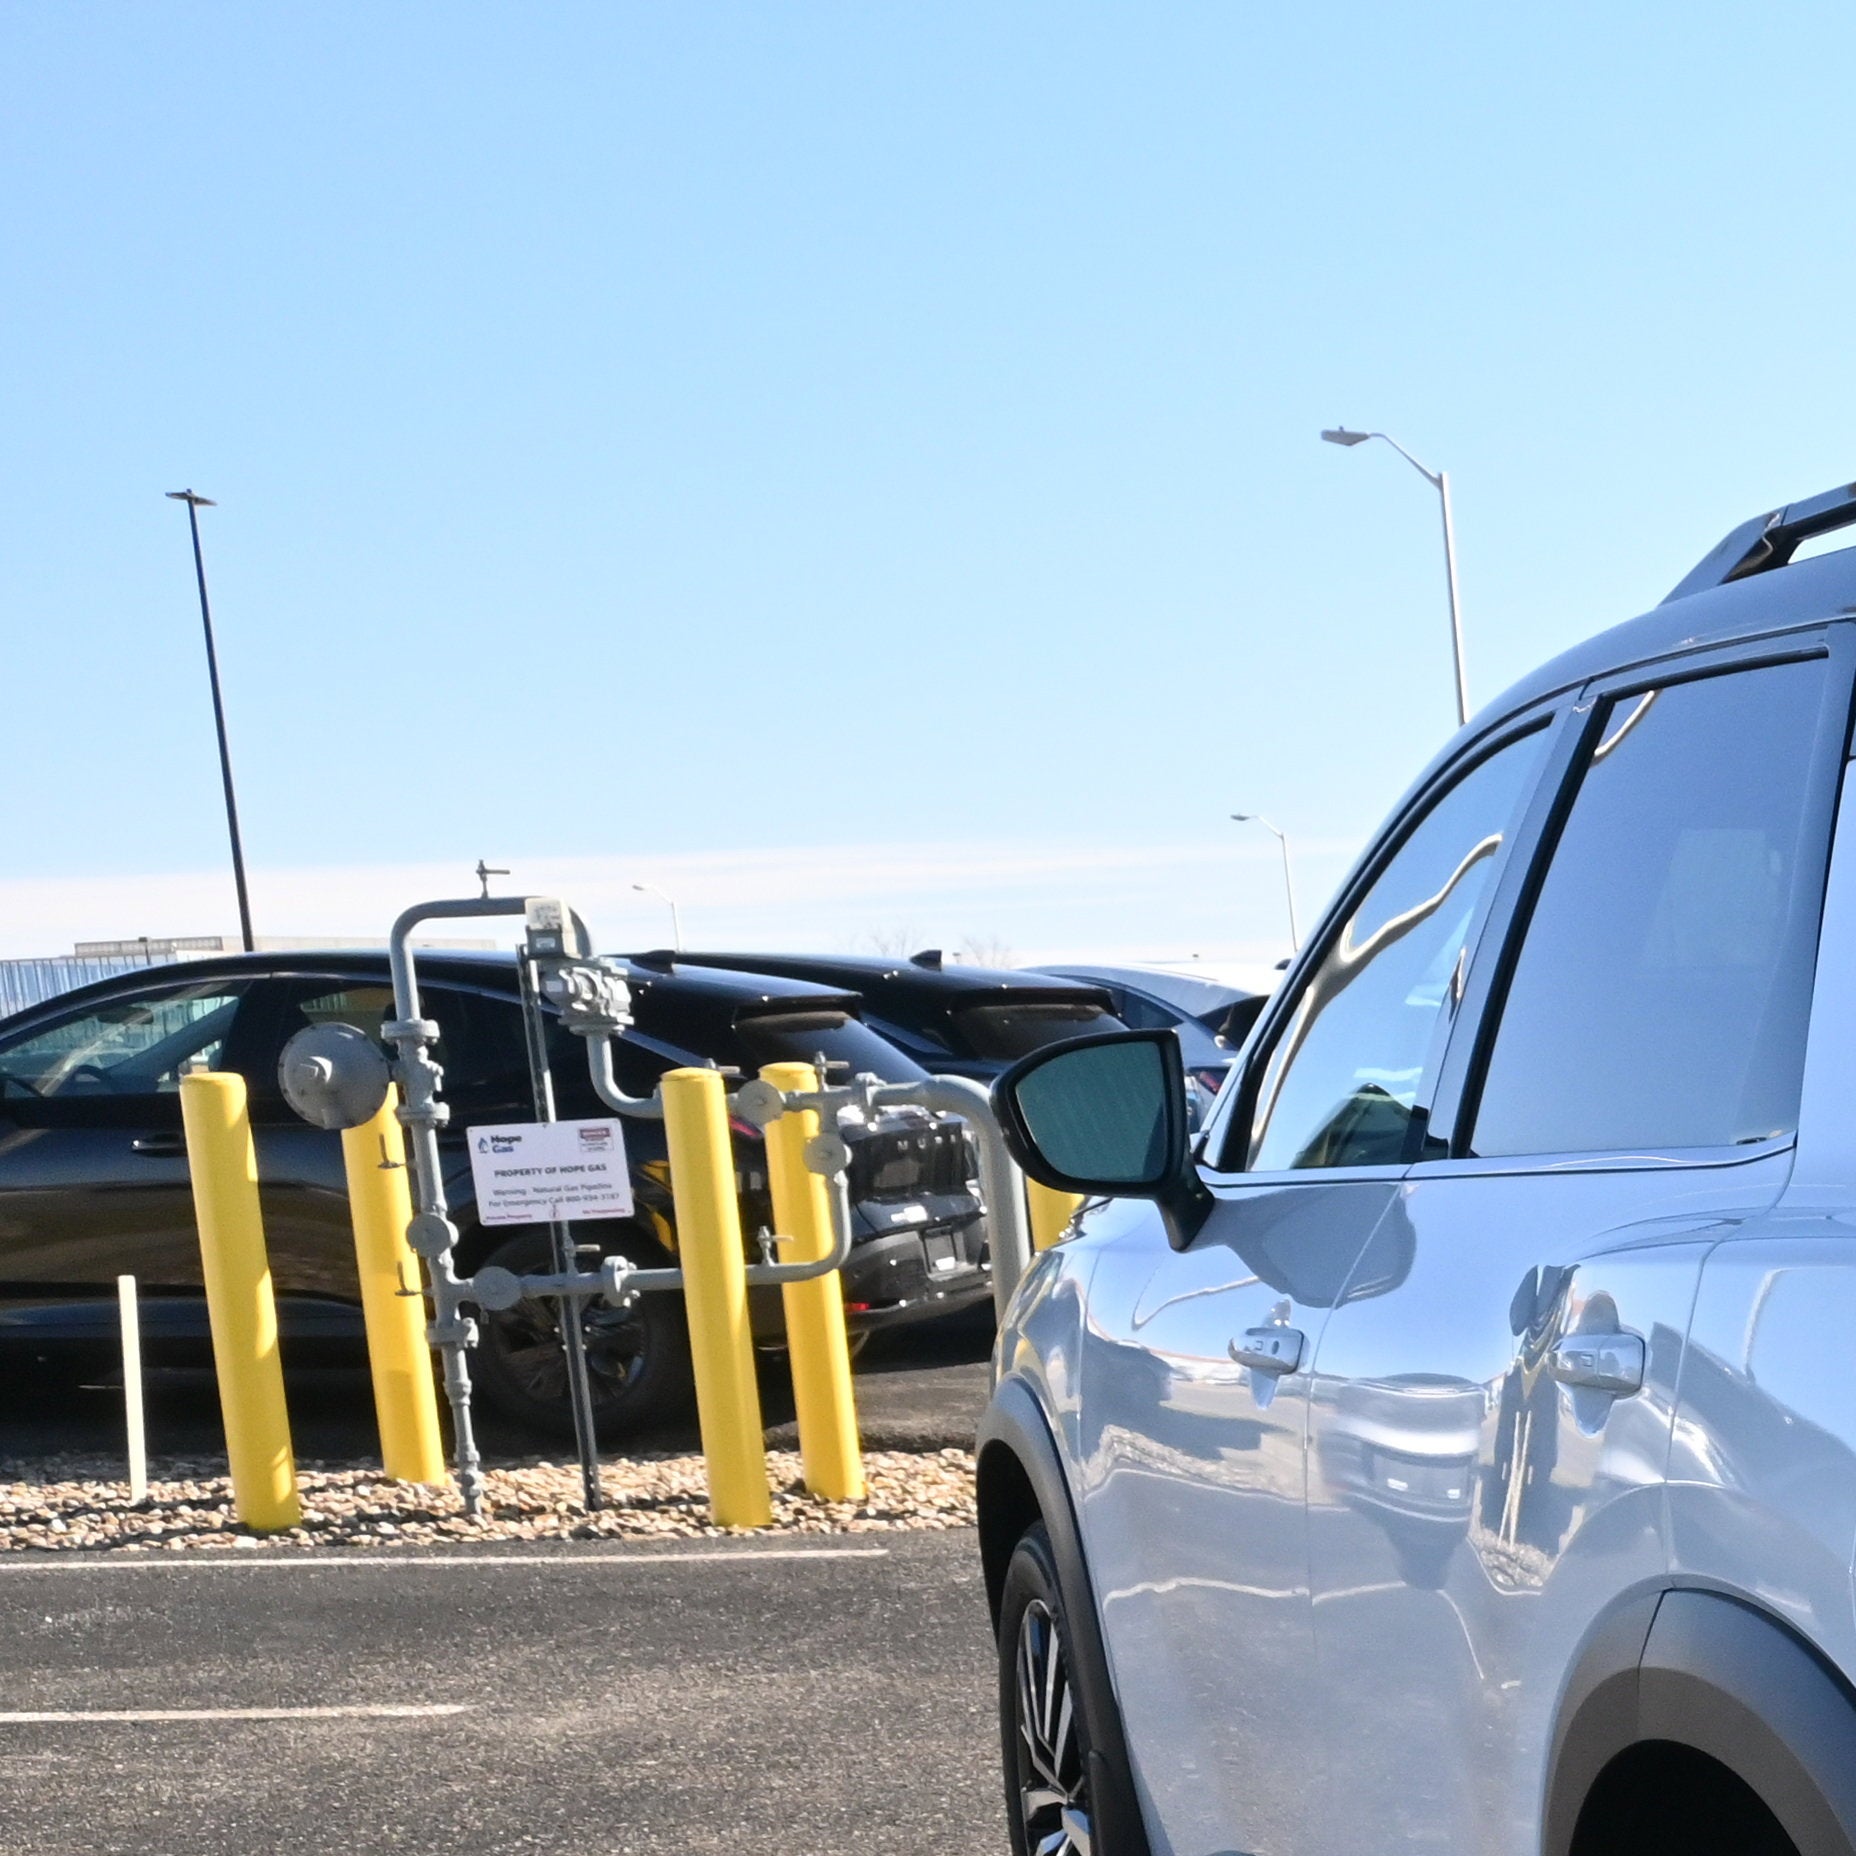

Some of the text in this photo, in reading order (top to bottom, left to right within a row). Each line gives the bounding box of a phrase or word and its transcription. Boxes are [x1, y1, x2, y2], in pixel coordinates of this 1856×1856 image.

[490, 1135, 522, 1145] Hope
[492, 1145, 514, 1153] Gas
[494, 1163, 607, 1178] PROPERTY OF HOPE GAS
[550, 1196, 564, 1204] Call
